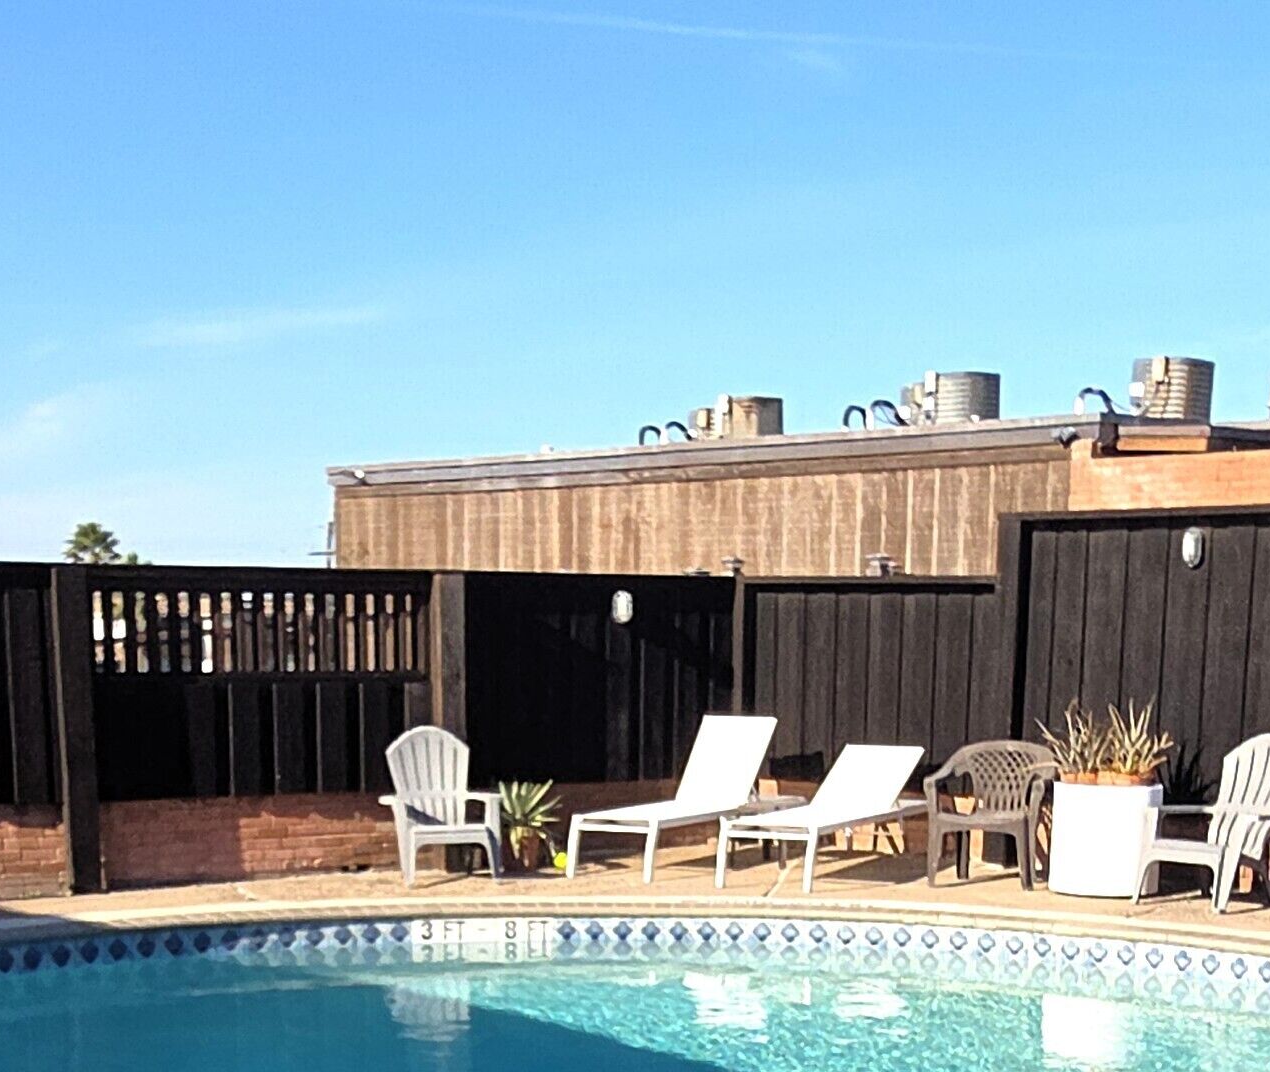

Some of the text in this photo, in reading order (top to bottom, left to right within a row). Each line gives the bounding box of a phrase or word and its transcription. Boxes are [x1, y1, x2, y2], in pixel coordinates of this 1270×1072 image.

[421, 920, 433, 940] 3
[444, 920, 465, 940] FT
[505, 920, 517, 939] 8
[528, 920, 549, 941] FT
